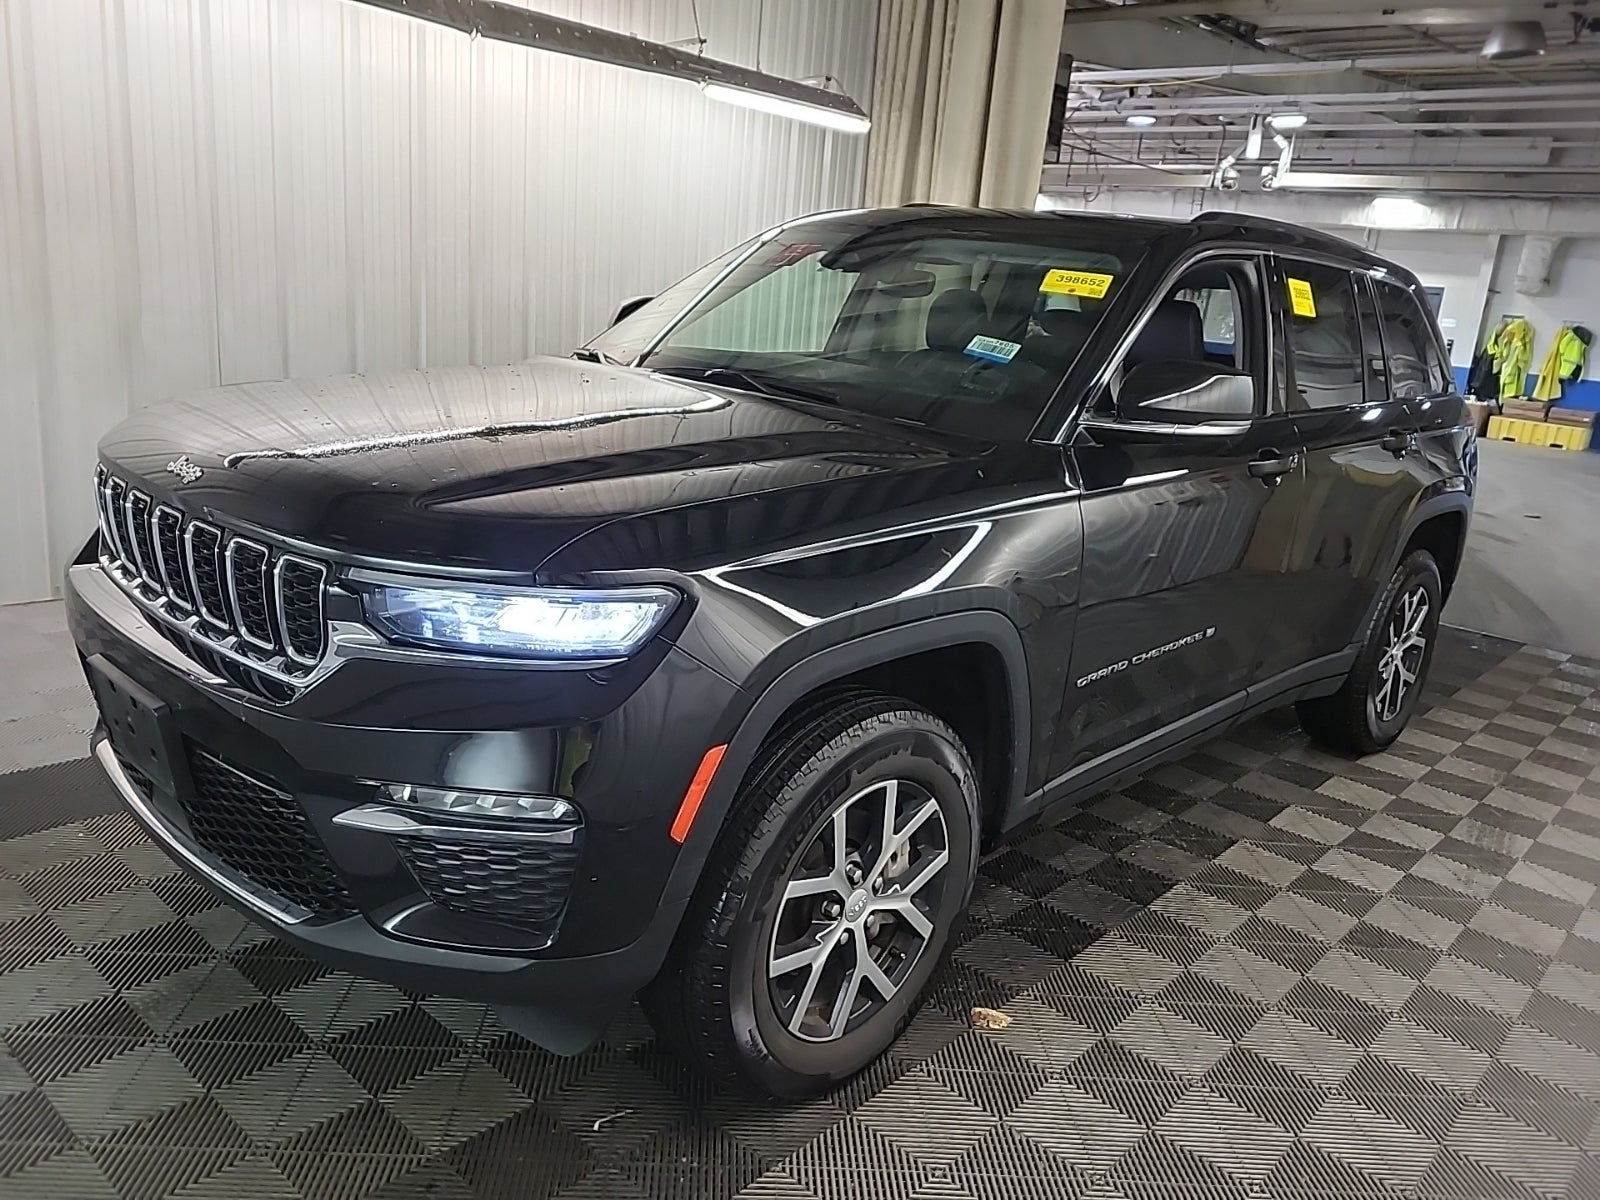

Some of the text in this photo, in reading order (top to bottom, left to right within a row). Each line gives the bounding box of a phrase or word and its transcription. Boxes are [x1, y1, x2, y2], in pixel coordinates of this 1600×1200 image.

[1055, 274, 1106, 288] 398652
[1076, 631, 1204, 688] GRAND CHEROKEE
